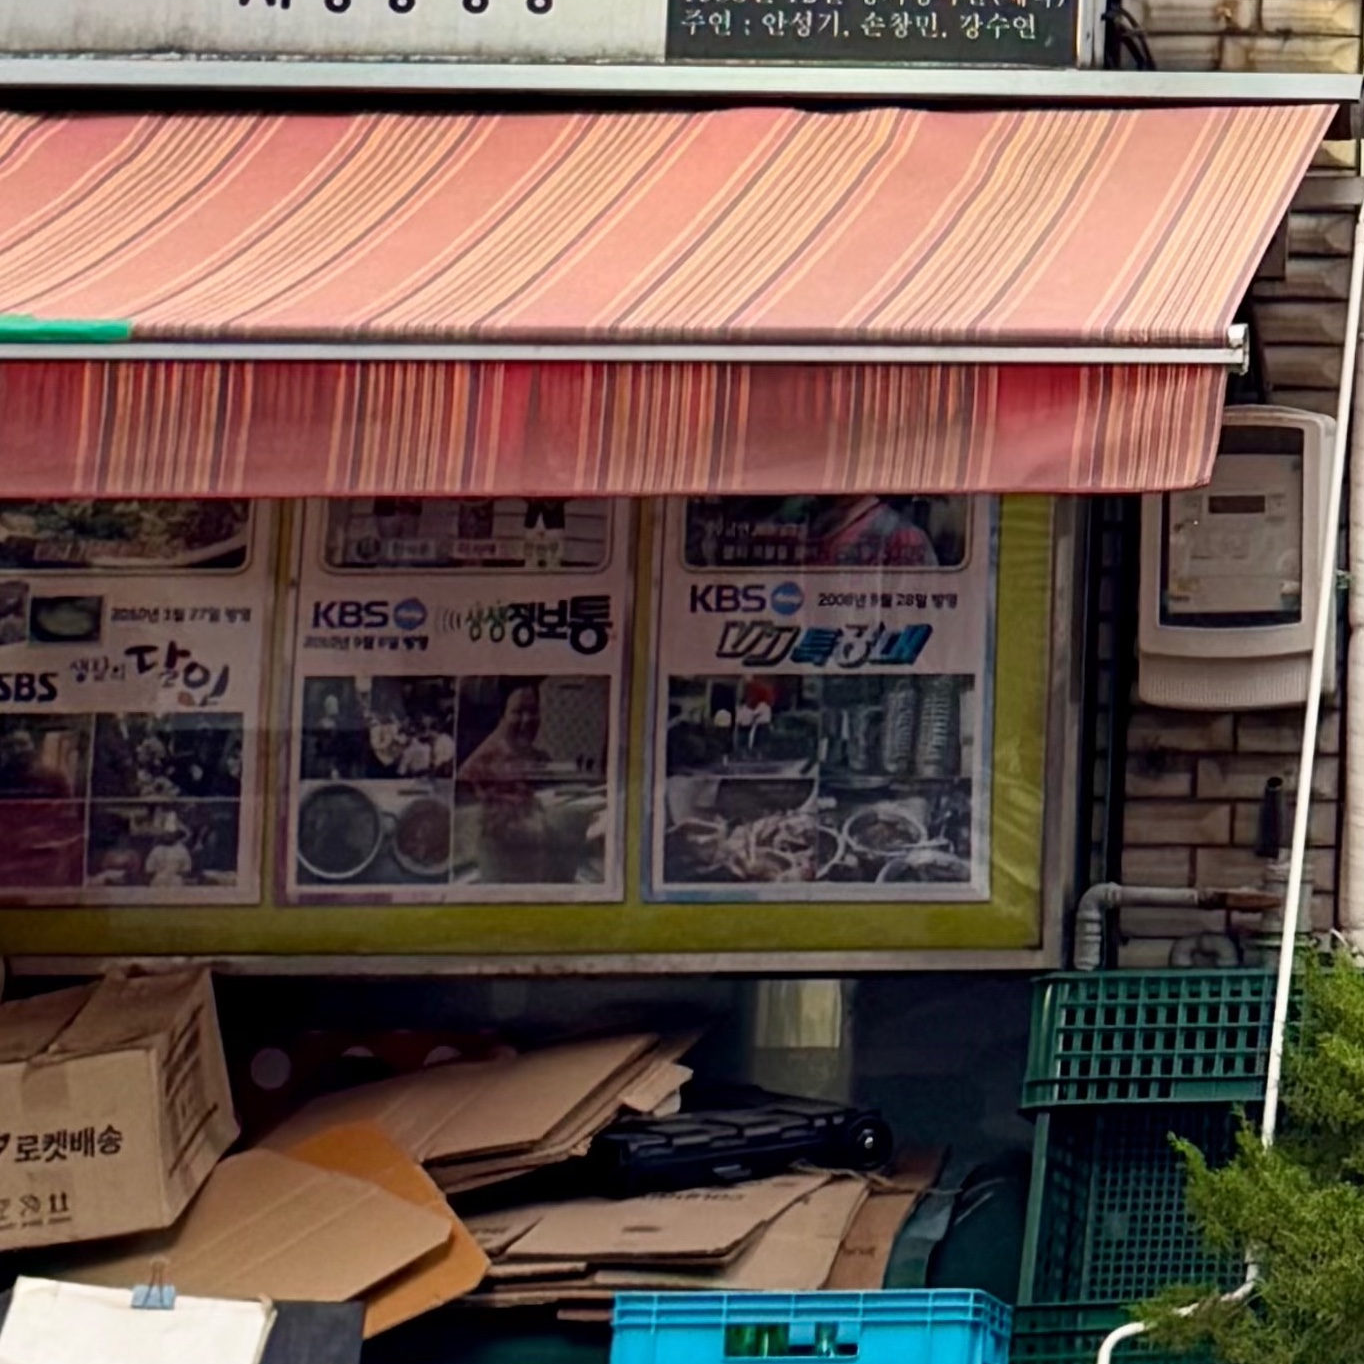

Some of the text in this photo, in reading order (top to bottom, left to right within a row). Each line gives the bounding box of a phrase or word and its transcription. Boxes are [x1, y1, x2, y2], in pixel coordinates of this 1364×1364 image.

[681, 9, 732, 36] 주연
[959, 13, 1036, 40] 강수연
[690, 584, 766, 614] KBS
[312, 600, 390, 629] KBS
[0, 672, 59, 702] SBS
[15, 1124, 124, 1163] 로켓배송
